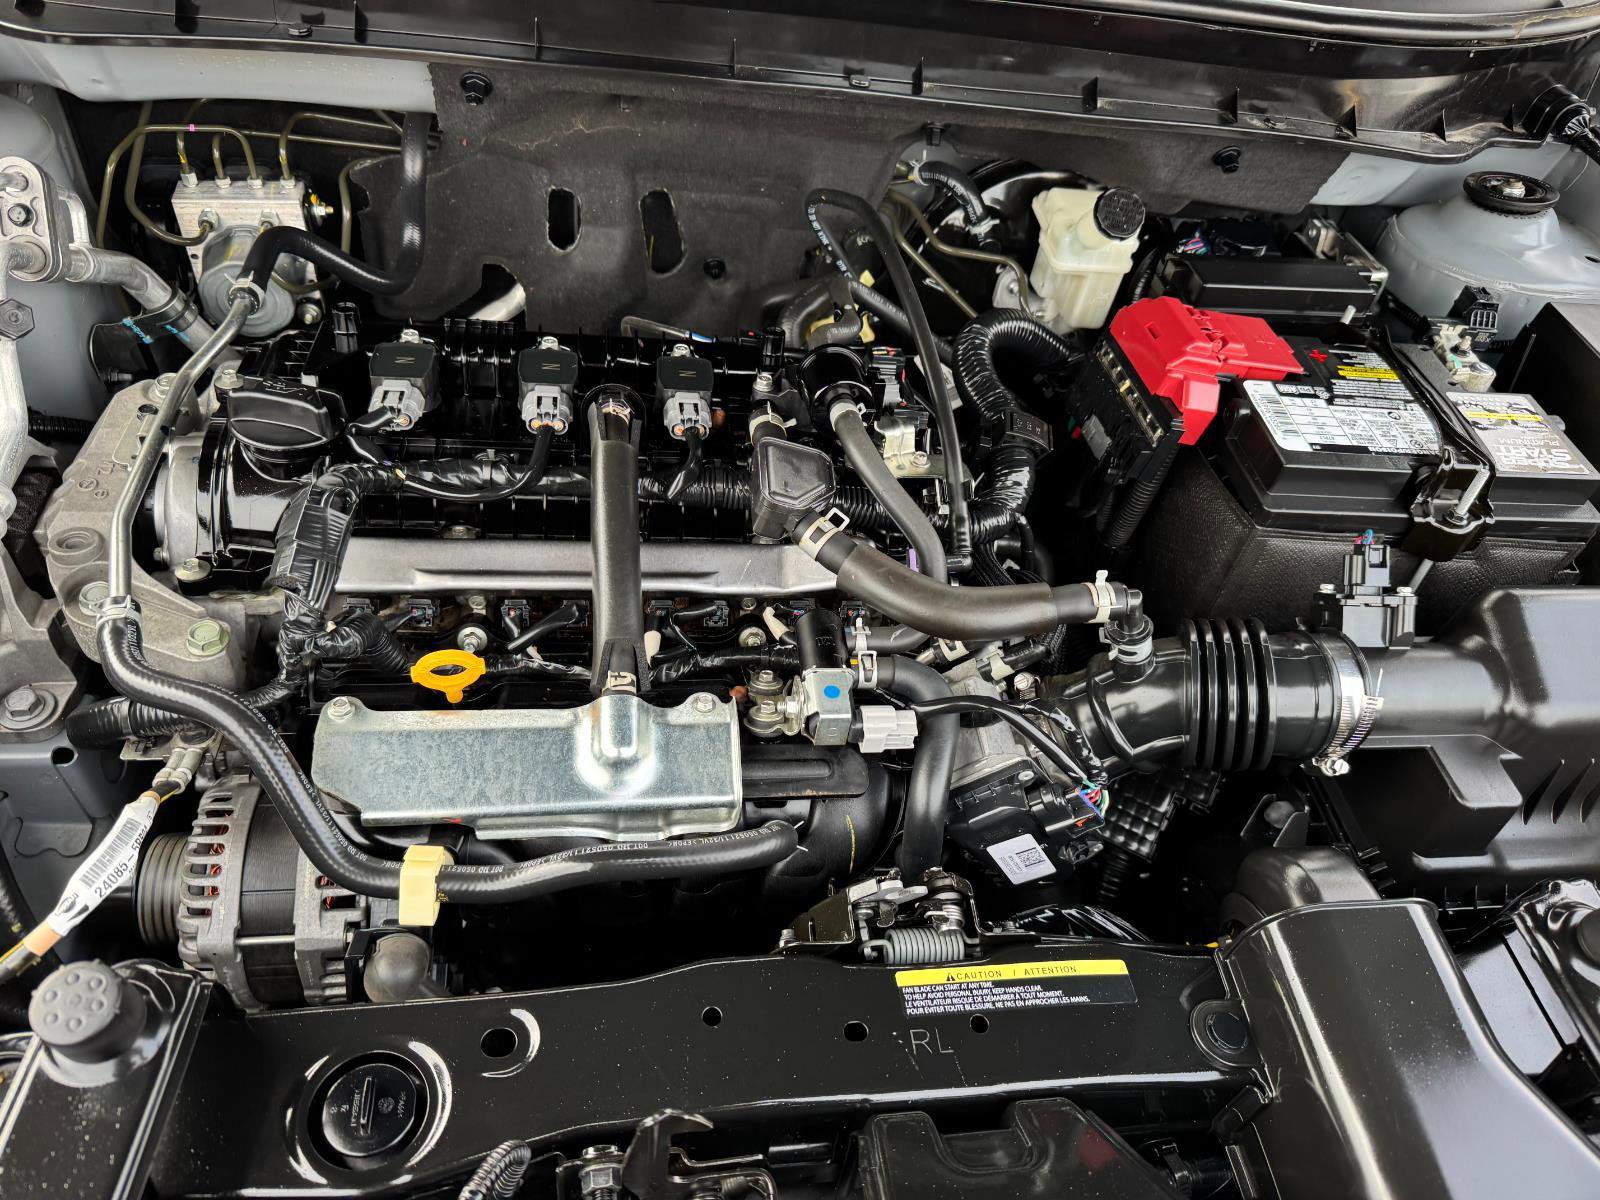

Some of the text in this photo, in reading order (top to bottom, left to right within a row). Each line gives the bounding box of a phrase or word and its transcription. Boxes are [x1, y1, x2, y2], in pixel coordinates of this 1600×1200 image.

[1498, 445, 1572, 462] START
[956, 970, 1002, 981] CAUTION
[1024, 966, 1077, 976] ATTENTION
[944, 983, 960, 991] START
[944, 990, 972, 998] PERSONAL
[906, 1006, 924, 1015] POUR
[944, 1004, 964, 1012] TOUTE
[1004, 1000, 1015, 1008] PAS
[1025, 997, 1059, 1006] APPROCHER
[1059, 996, 1070, 1004] LES
[913, 998, 952, 1007] VENTILATEUR
[952, 997, 974, 1005] RISQUE
[909, 1027, 955, 1056] RL
